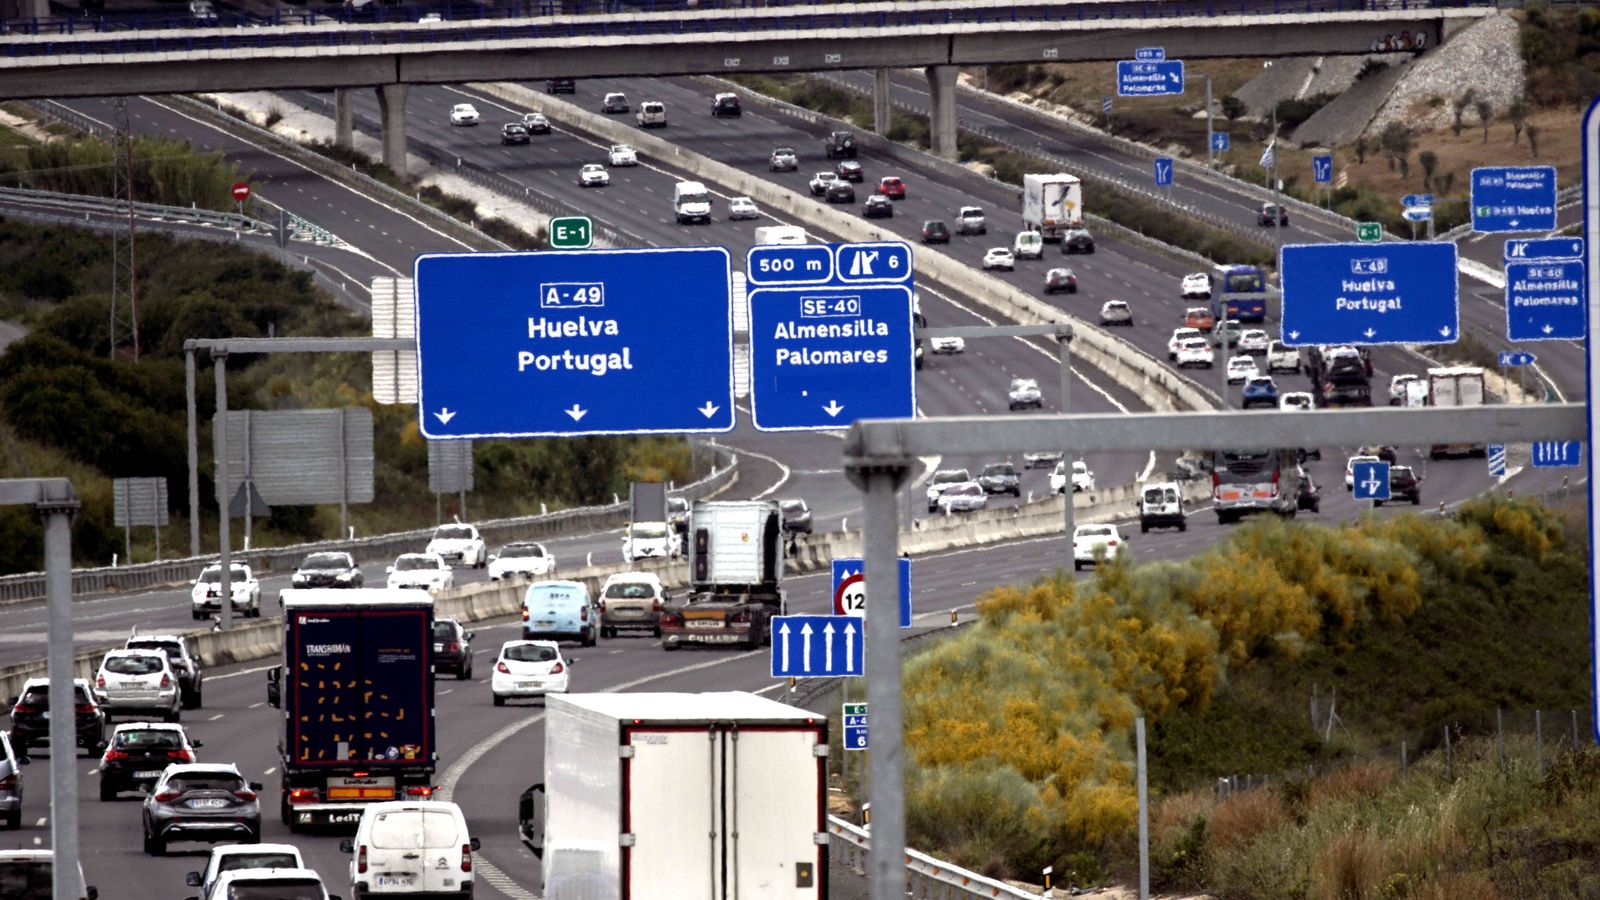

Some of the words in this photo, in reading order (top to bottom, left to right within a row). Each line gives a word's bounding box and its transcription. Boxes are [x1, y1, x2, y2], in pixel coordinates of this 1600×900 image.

[556, 226, 586, 240] E-1
[759, 258, 795, 272] 500
[806, 260, 822, 271] m
[888, 255, 900, 269] 6
[1354, 261, 1384, 272] A-49
[1342, 278, 1395, 292] Huelva
[1513, 279, 1579, 291] Almensilla
[546, 287, 601, 305] A-49
[1513, 295, 1578, 306] Palomares
[803, 299, 858, 315] SE-40
[1336, 297, 1402, 313] Portugal
[528, 316, 619, 338] Huelva
[774, 319, 889, 340] Almensilla
[518, 347, 633, 376] Portugal
[776, 348, 889, 366] Palomares
[845, 593, 865, 610] 12
[849, 717, 867, 725] A-4
[329, 813, 361, 823] LeciT
